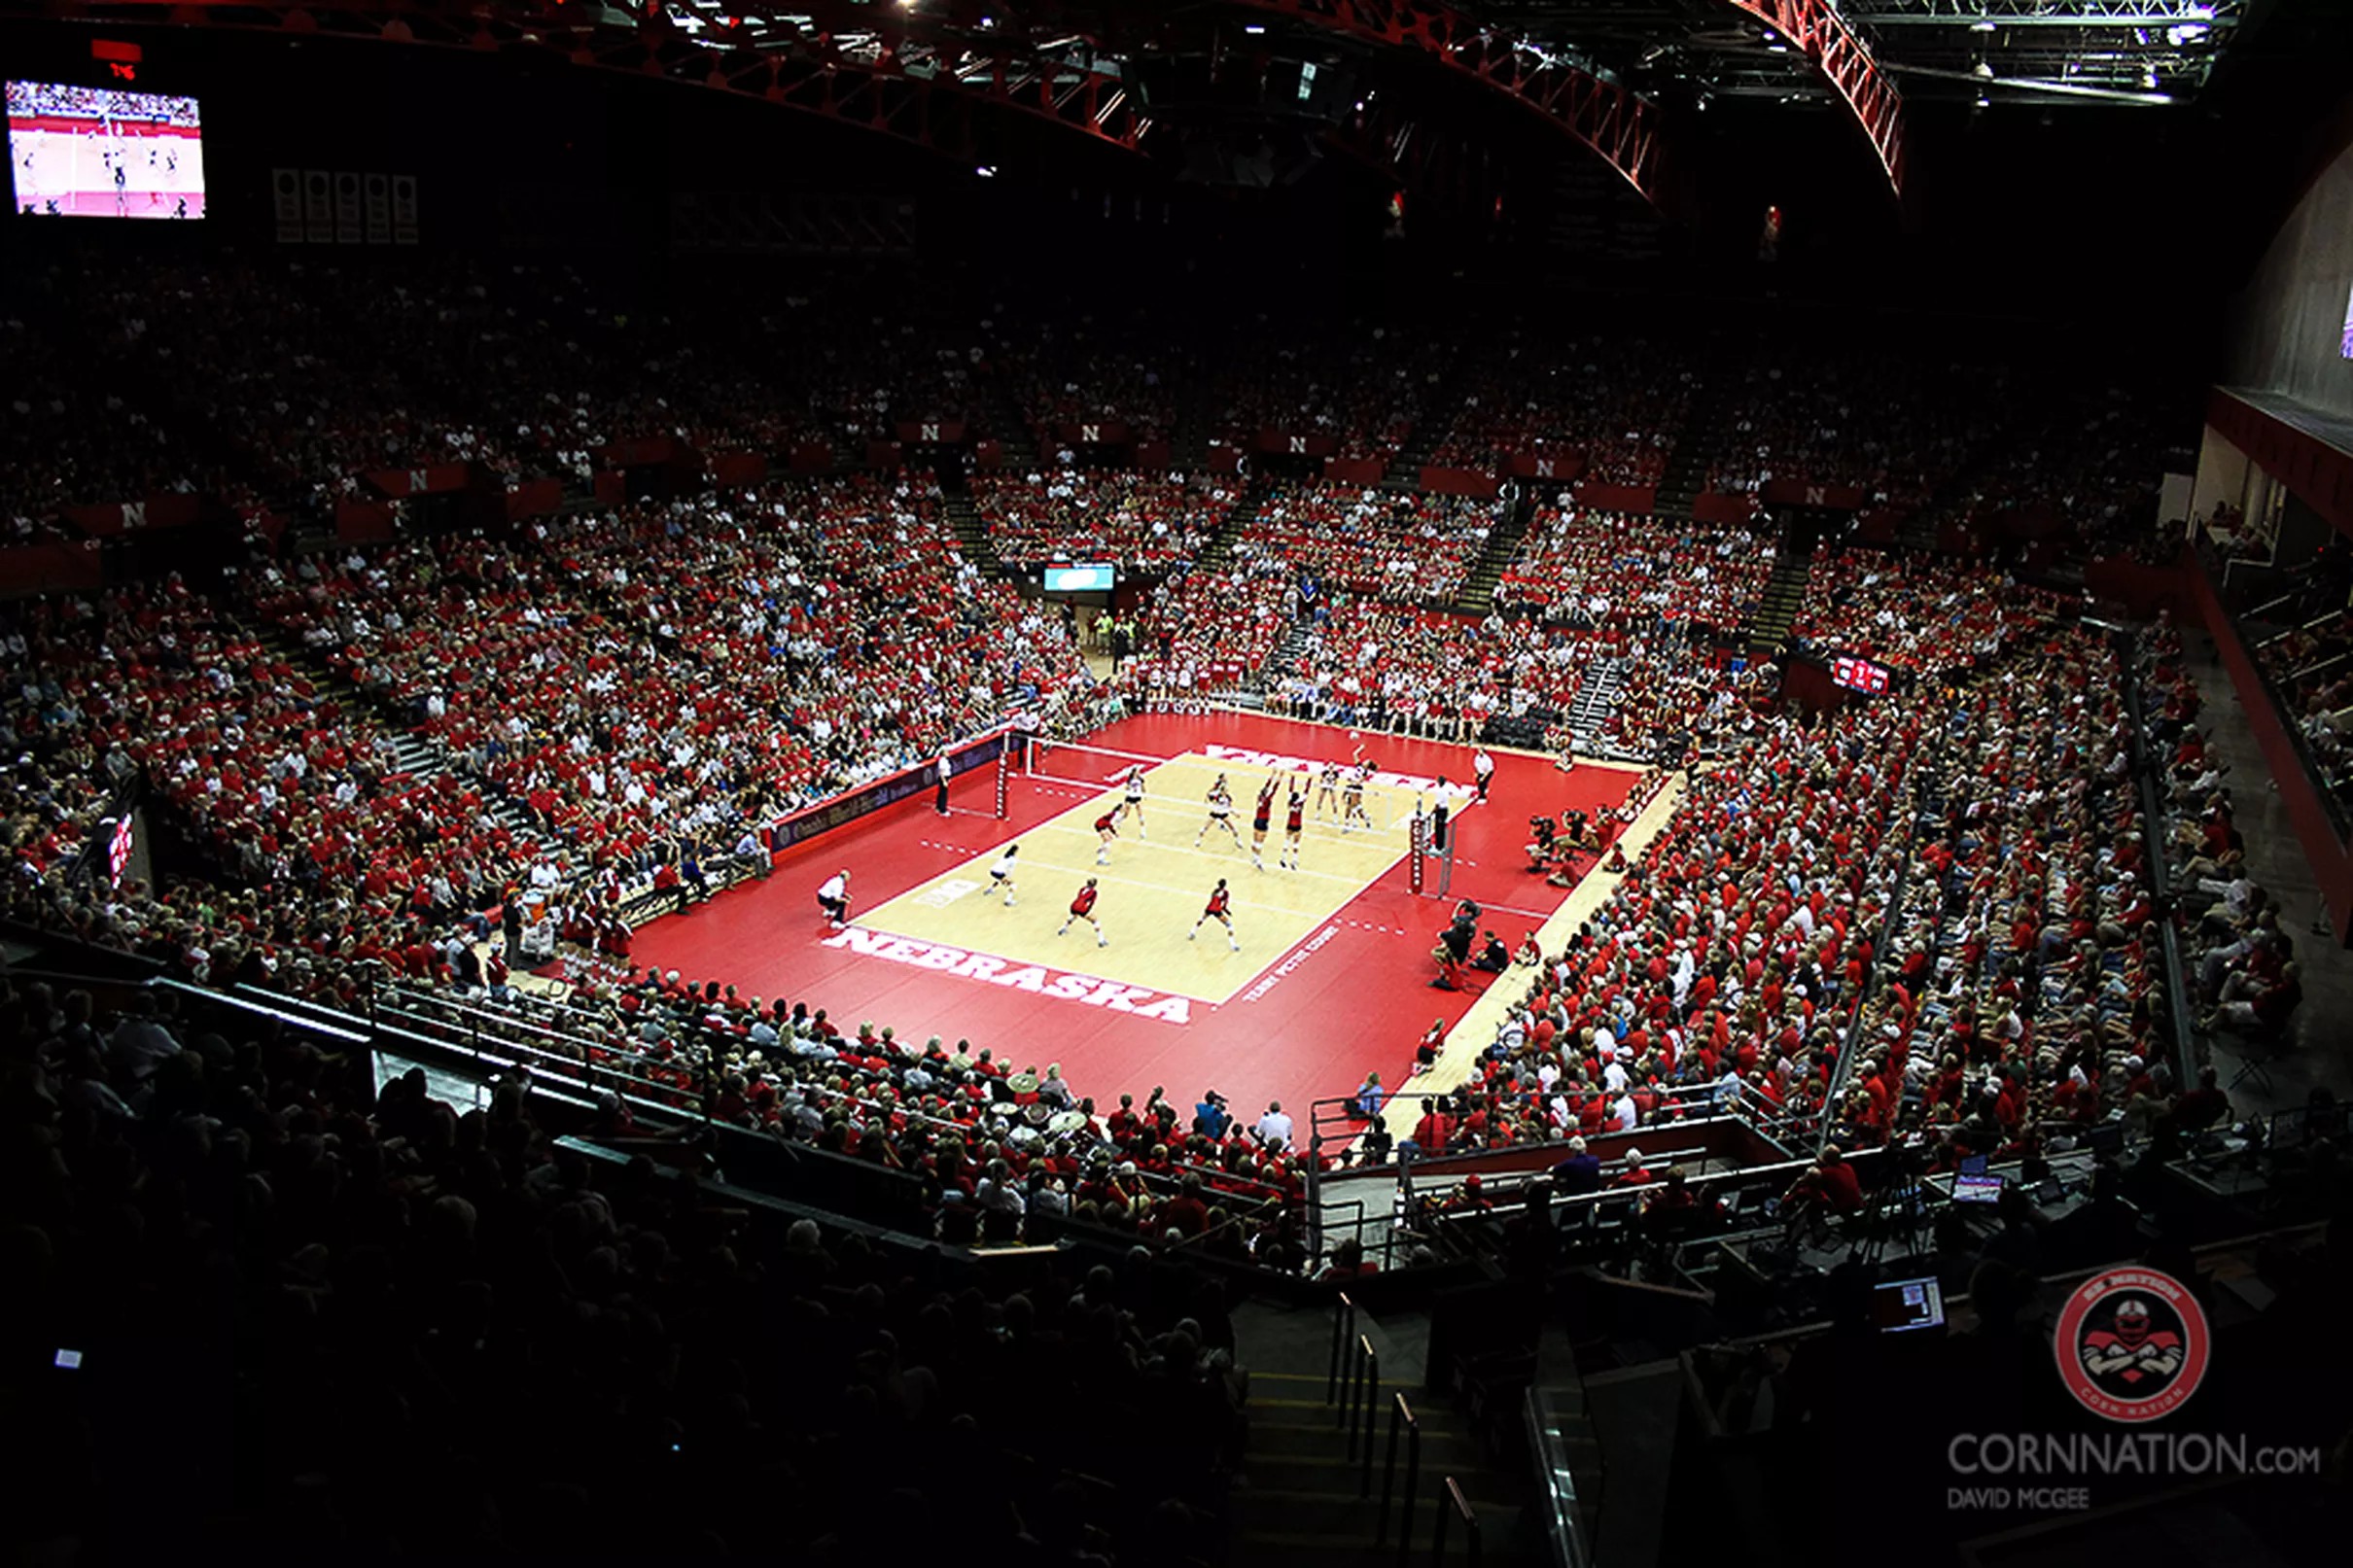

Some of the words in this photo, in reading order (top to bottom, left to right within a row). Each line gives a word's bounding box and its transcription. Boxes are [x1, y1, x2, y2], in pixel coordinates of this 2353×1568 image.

[921, 424, 939, 440] N
[1082, 425, 1100, 441] N
[1289, 436, 1306, 453] N
[1535, 460, 1555, 476] N
[409, 469, 429, 491] N
[1806, 487, 1825, 505] N
[122, 502, 146, 528] N
[822, 928, 1190, 1024] NEBRASKA
